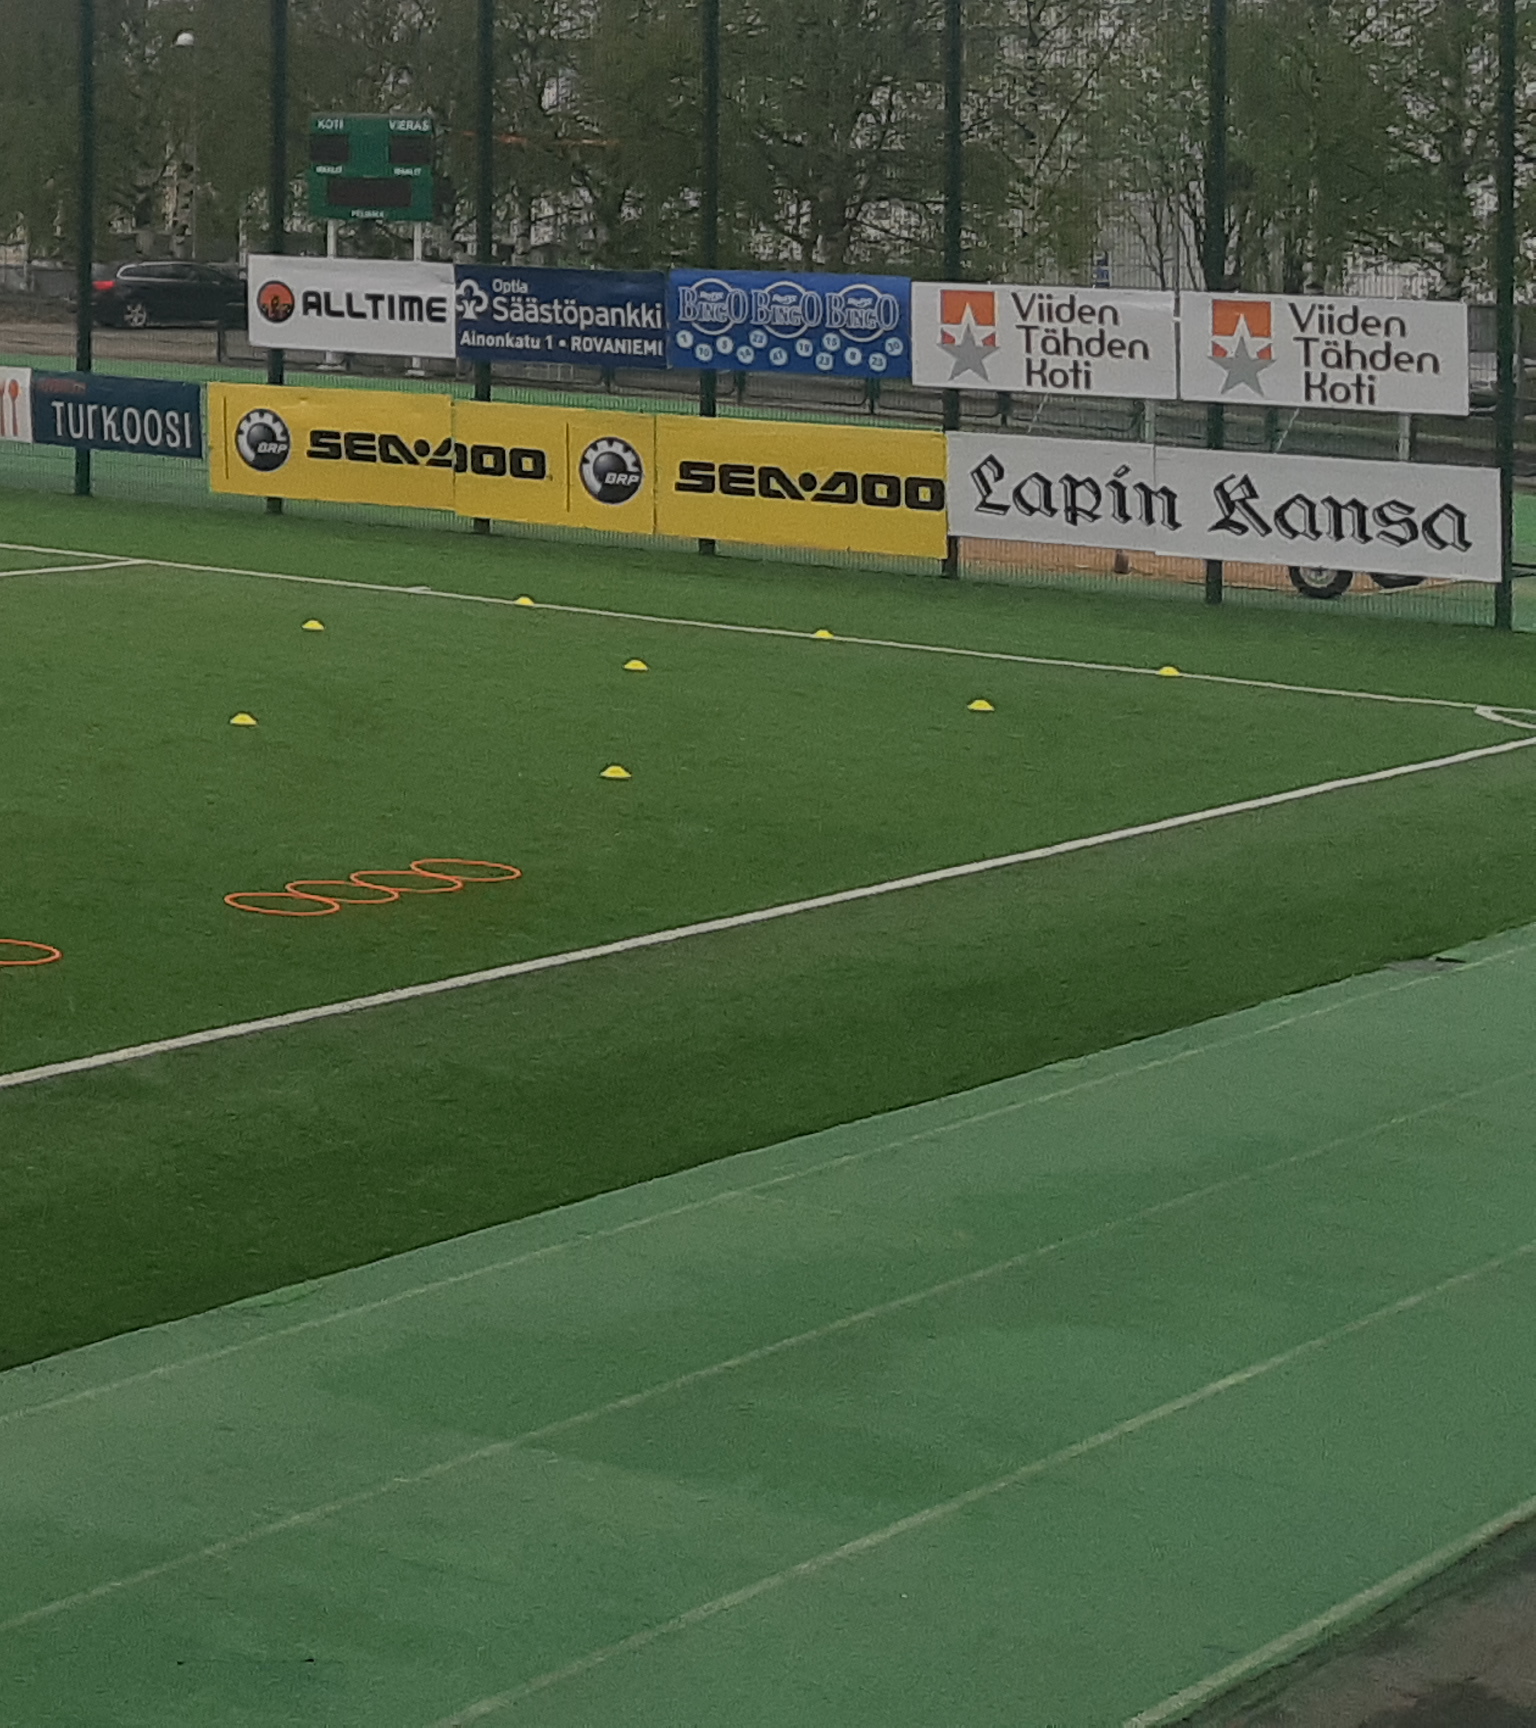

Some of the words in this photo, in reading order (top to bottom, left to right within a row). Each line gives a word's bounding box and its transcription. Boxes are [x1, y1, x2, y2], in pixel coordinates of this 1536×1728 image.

[316, 118, 344, 130] KOTI
[389, 119, 429, 131] VIERAS
[491, 278, 528, 294] Optia
[301, 287, 448, 324] ALLTIME
[492, 296, 663, 330] Säästöpankki
[1011, 290, 1119, 326] Viiden
[1288, 301, 1407, 337] Viiden
[460, 330, 541, 350] Ainonkatu
[544, 335, 553, 350] 1
[570, 335, 664, 356] ROVANIEMI
[1015, 324, 1150, 361] Tähden
[1292, 336, 1441, 374] Tähden
[1026, 357, 1092, 390] Koti
[1304, 372, 1376, 405] Koti
[603, 472, 641, 486] BRP
[970, 452, 1182, 531] Lapin
[1208, 473, 1473, 553] Kansa
